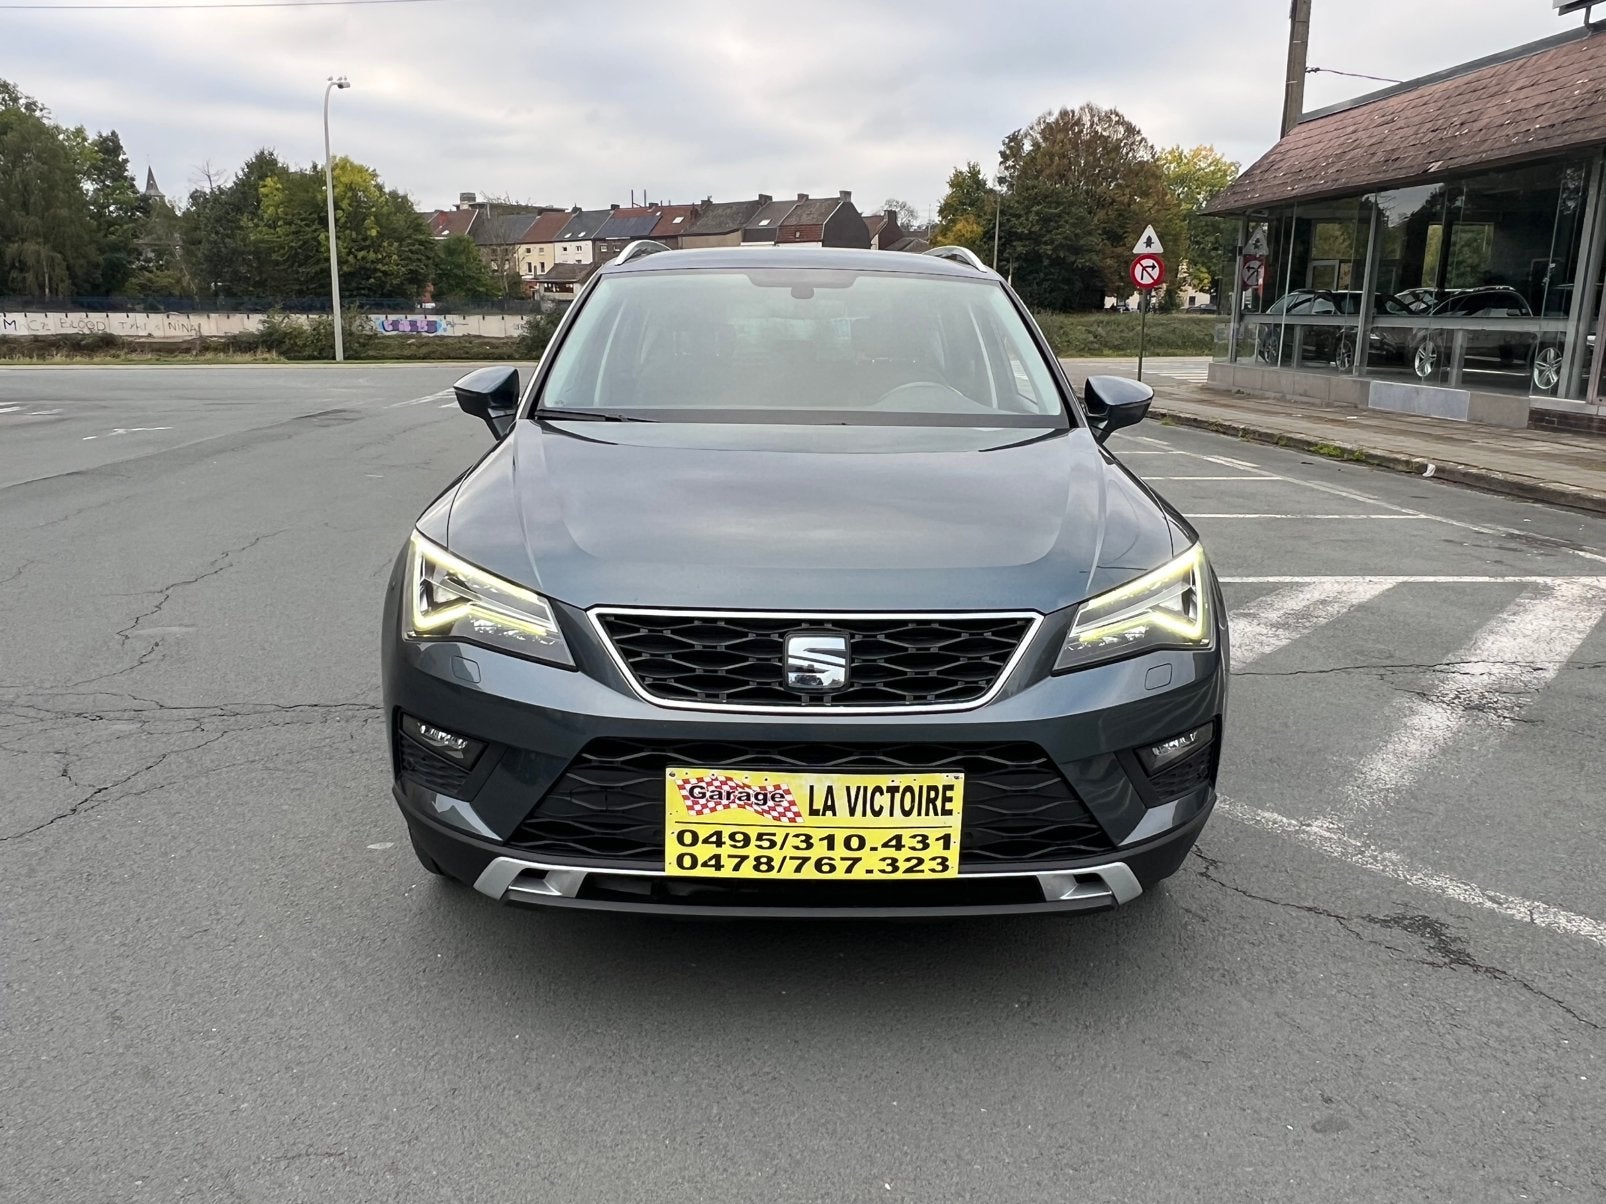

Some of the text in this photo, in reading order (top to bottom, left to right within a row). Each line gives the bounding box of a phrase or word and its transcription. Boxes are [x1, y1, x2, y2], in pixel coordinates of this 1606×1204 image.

[688, 785, 955, 817] Garage LA VICTOIRE
[676, 828, 952, 852] 0495/310.431
[676, 852, 951, 875] 0478/767.323
